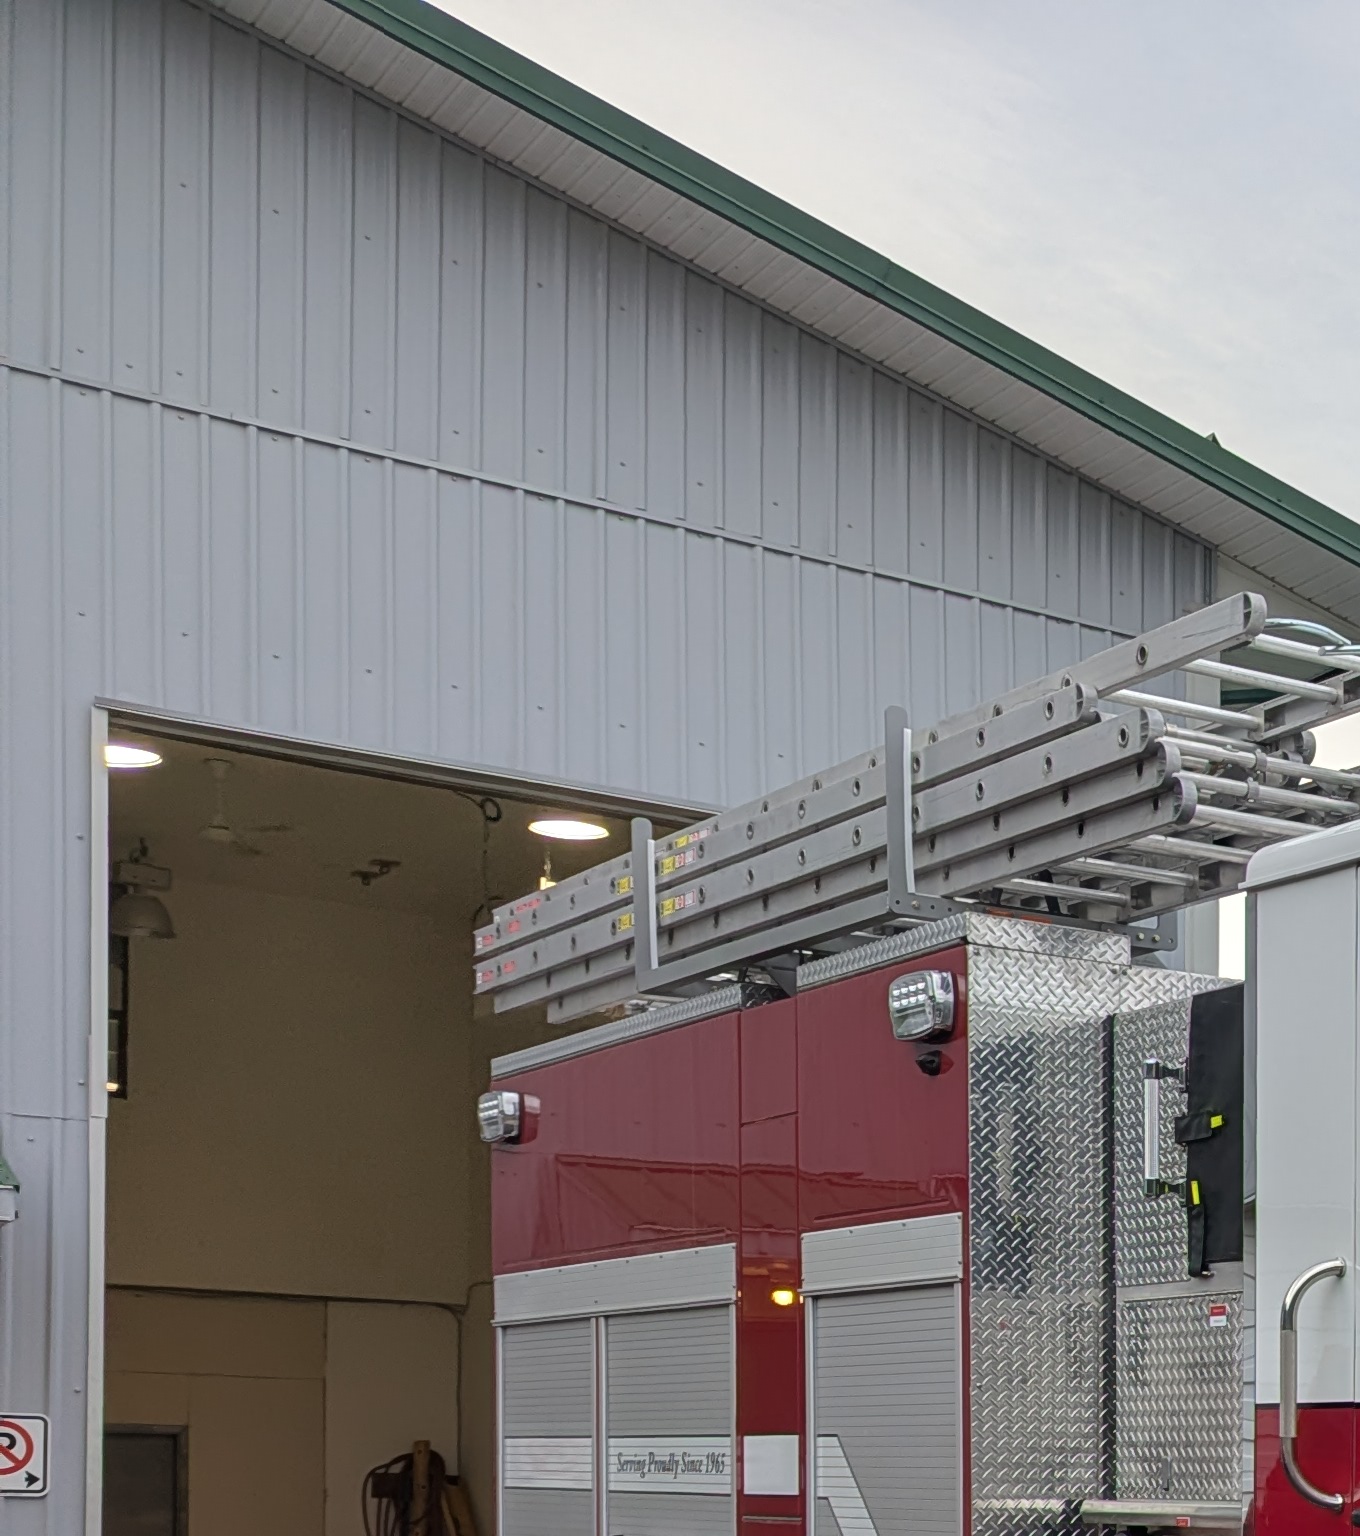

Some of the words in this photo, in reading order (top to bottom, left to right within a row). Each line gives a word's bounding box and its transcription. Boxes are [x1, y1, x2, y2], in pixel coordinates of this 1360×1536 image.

[616, 1452, 646, 1479] Serving
[647, 1452, 680, 1480] Proudly
[681, 1452, 703, 1473] Since
[705, 1452, 726, 1474] 1965
